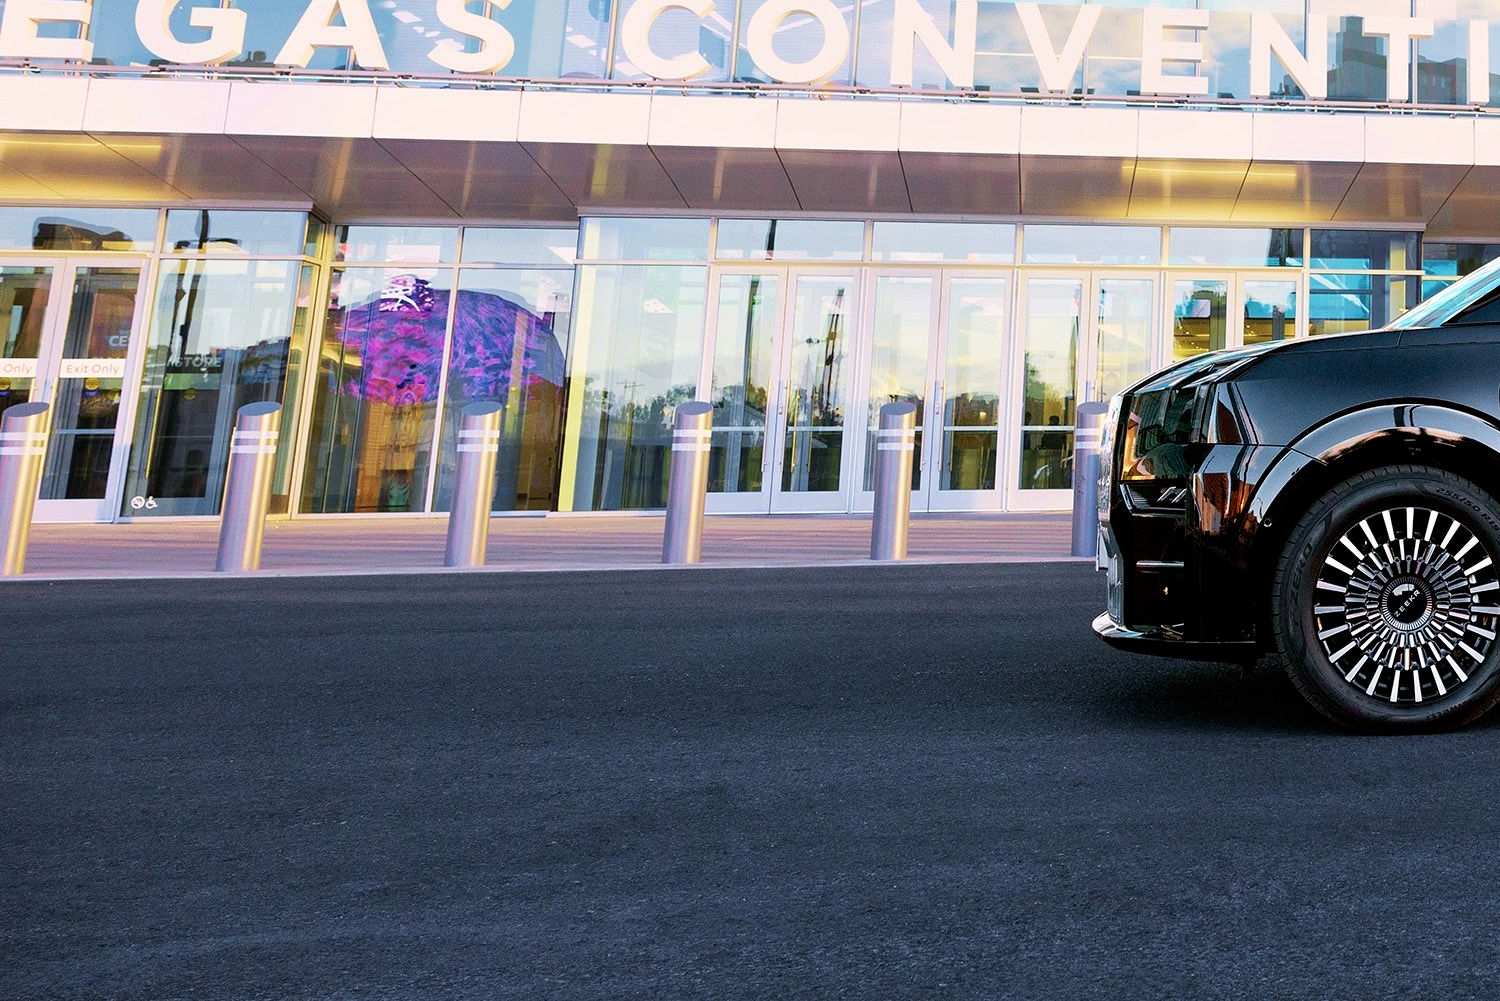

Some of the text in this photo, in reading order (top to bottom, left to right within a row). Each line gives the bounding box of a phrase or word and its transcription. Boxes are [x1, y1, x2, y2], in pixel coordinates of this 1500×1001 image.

[108, 334, 130, 347] CE
[3, 363, 32, 375] Only
[66, 363, 120, 375] Exit Only
[1436, 487, 1481, 512] 255/50
[1394, 589, 1421, 617] ZEEKR
